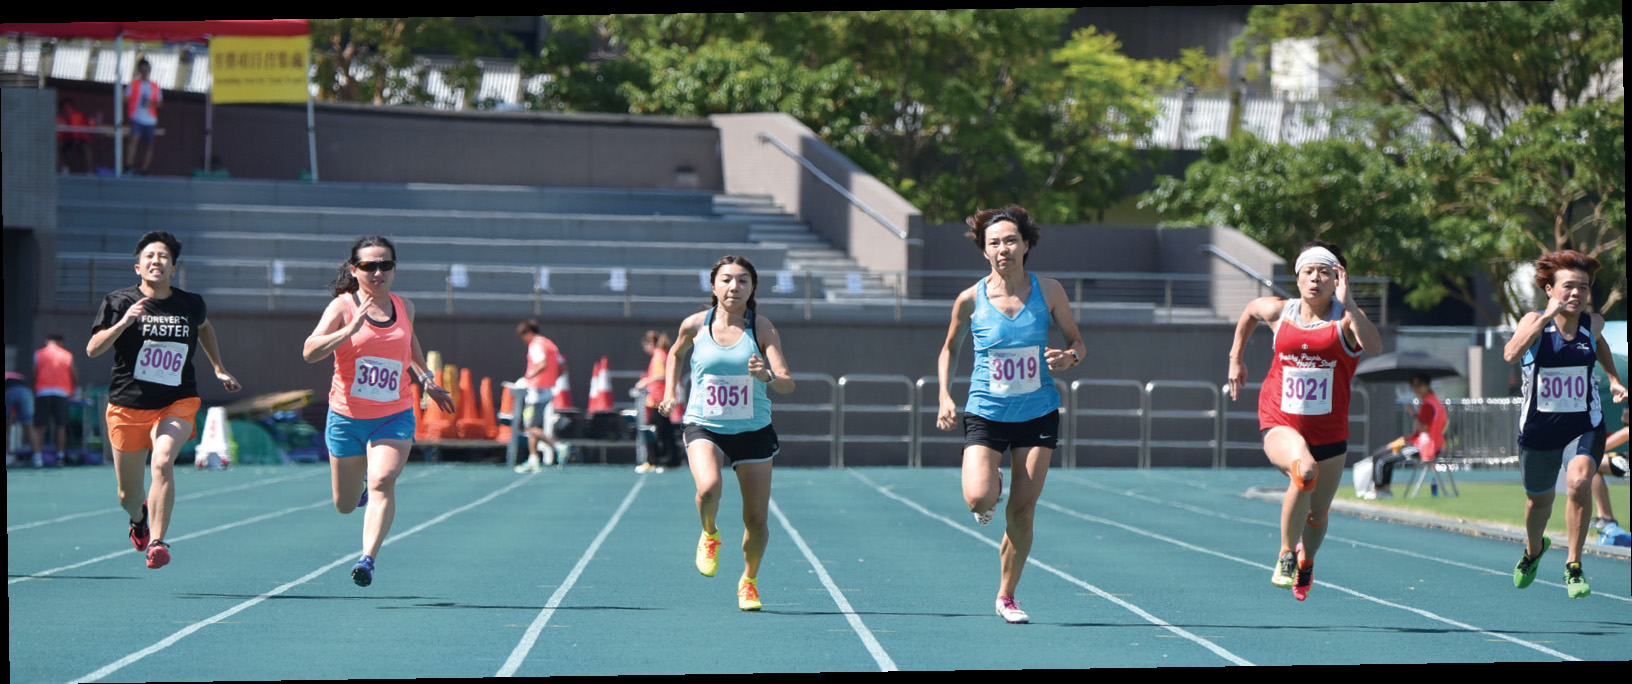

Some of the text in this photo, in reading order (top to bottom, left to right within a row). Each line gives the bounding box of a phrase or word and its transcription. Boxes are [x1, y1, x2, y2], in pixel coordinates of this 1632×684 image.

[141, 315, 180, 324] FOREVER
[142, 324, 189, 337] FASTER
[140, 347, 183, 372] 3006
[992, 356, 1037, 381] 3019
[1301, 353, 1321, 362] People
[357, 365, 399, 391] 3096
[1285, 377, 1327, 400] 3021
[1541, 376, 1585, 399] 3010
[706, 385, 748, 407] 3051
